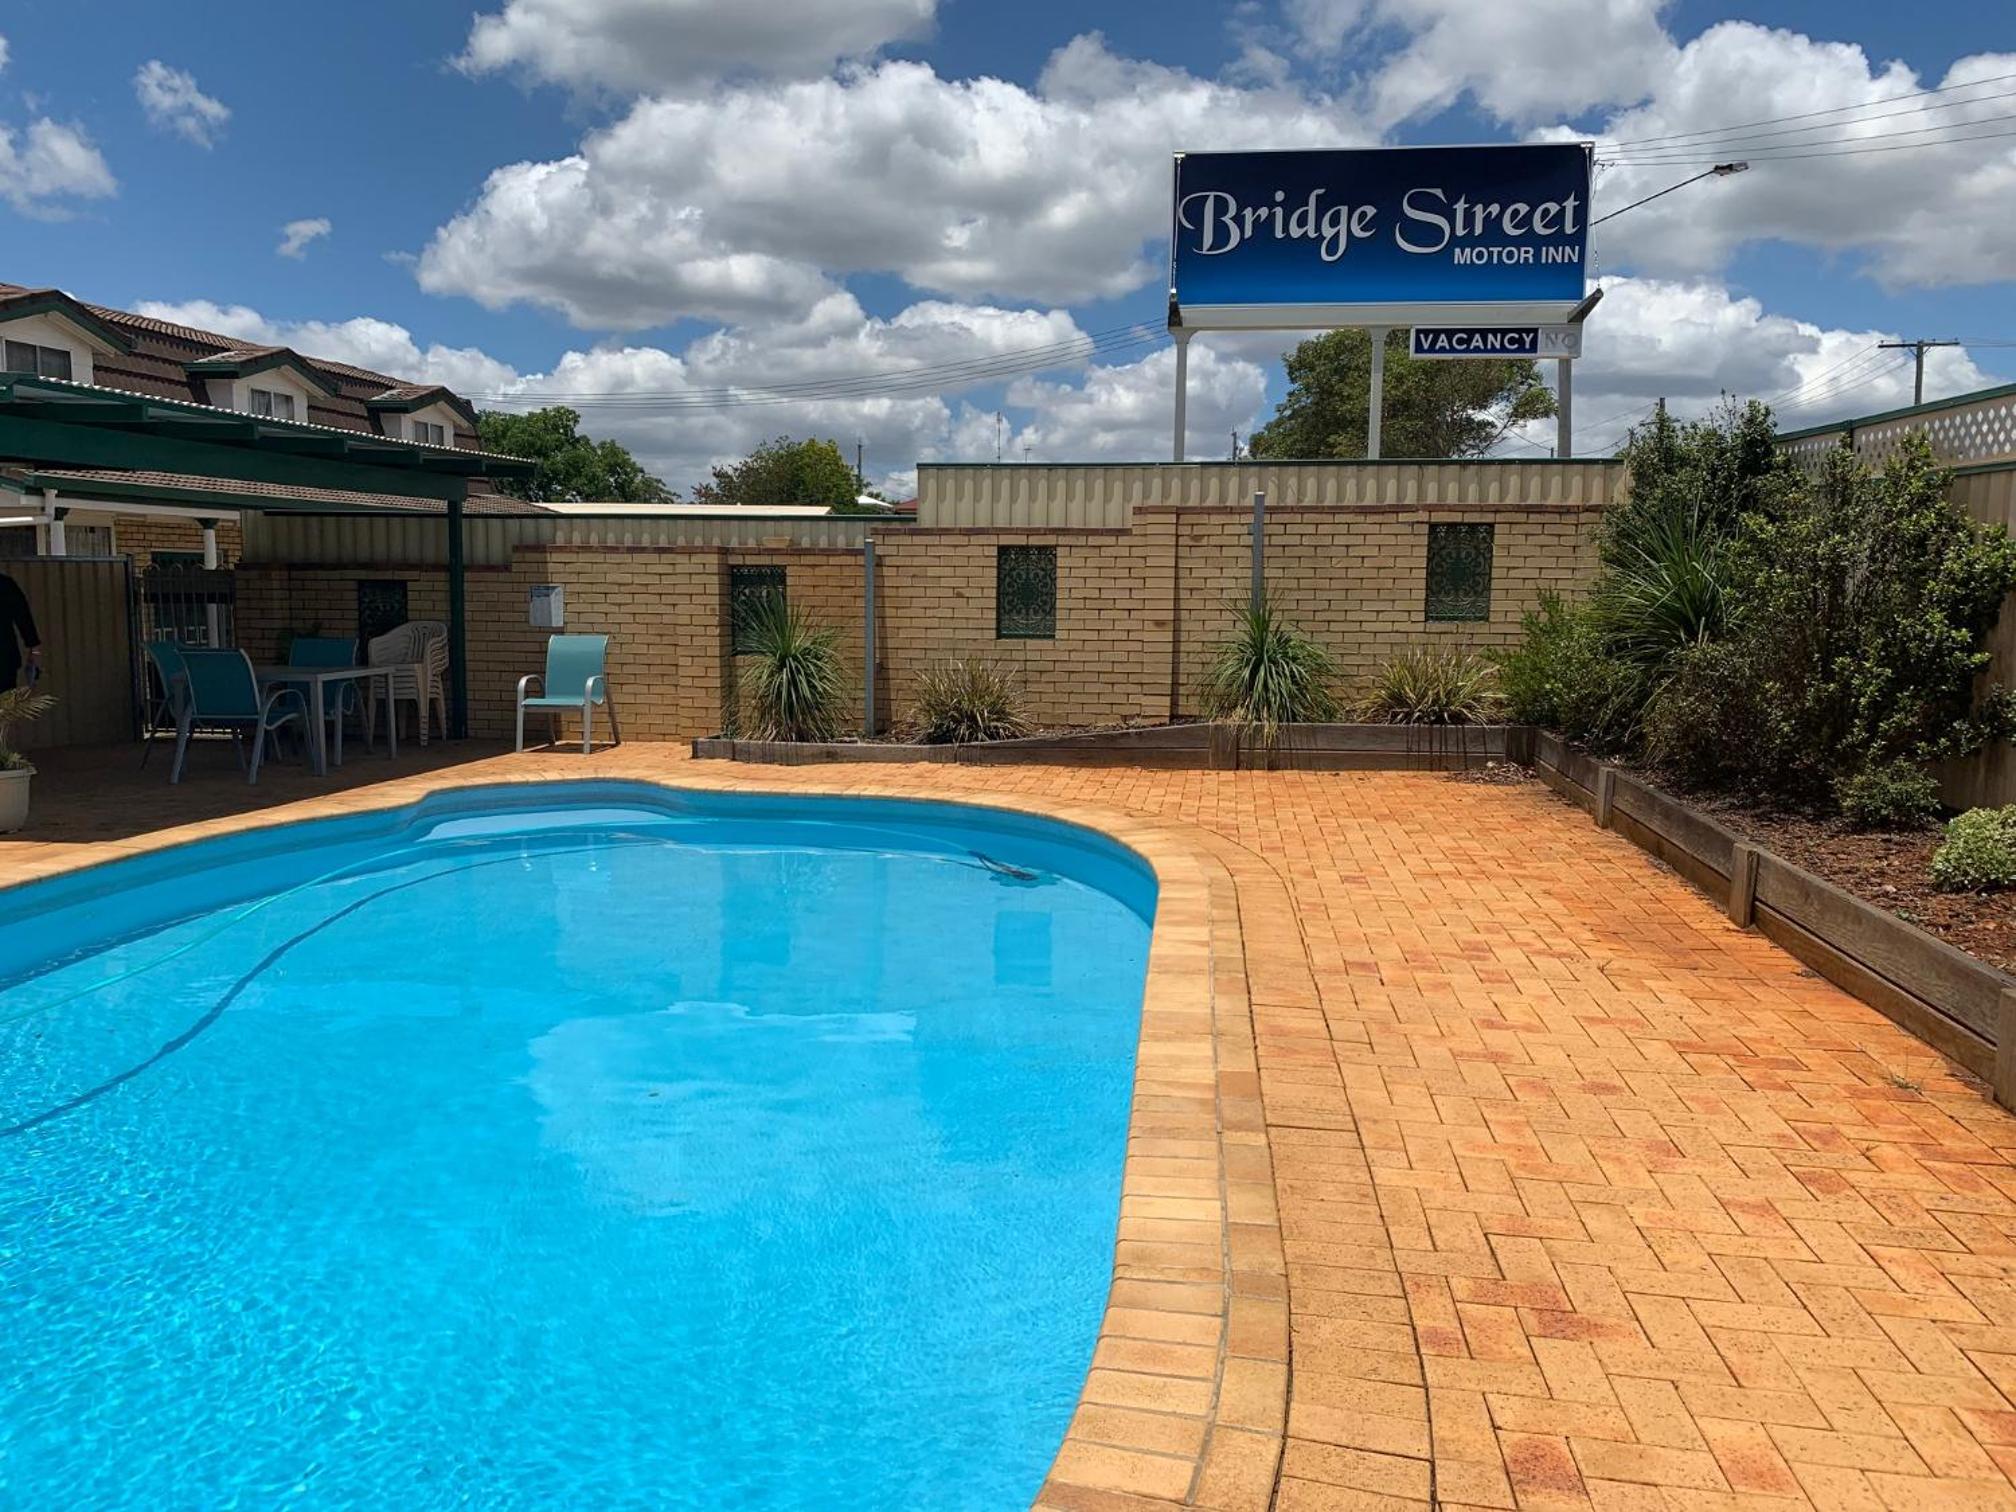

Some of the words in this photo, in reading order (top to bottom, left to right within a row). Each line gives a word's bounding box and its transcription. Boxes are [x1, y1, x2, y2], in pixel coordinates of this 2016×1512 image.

[1178, 188, 1378, 262] Bridge
[1395, 188, 1581, 253] Street
[1453, 246, 1535, 265] MOTOR
[1540, 245, 1580, 264] INN
[1419, 332, 1535, 350] VACANCY
